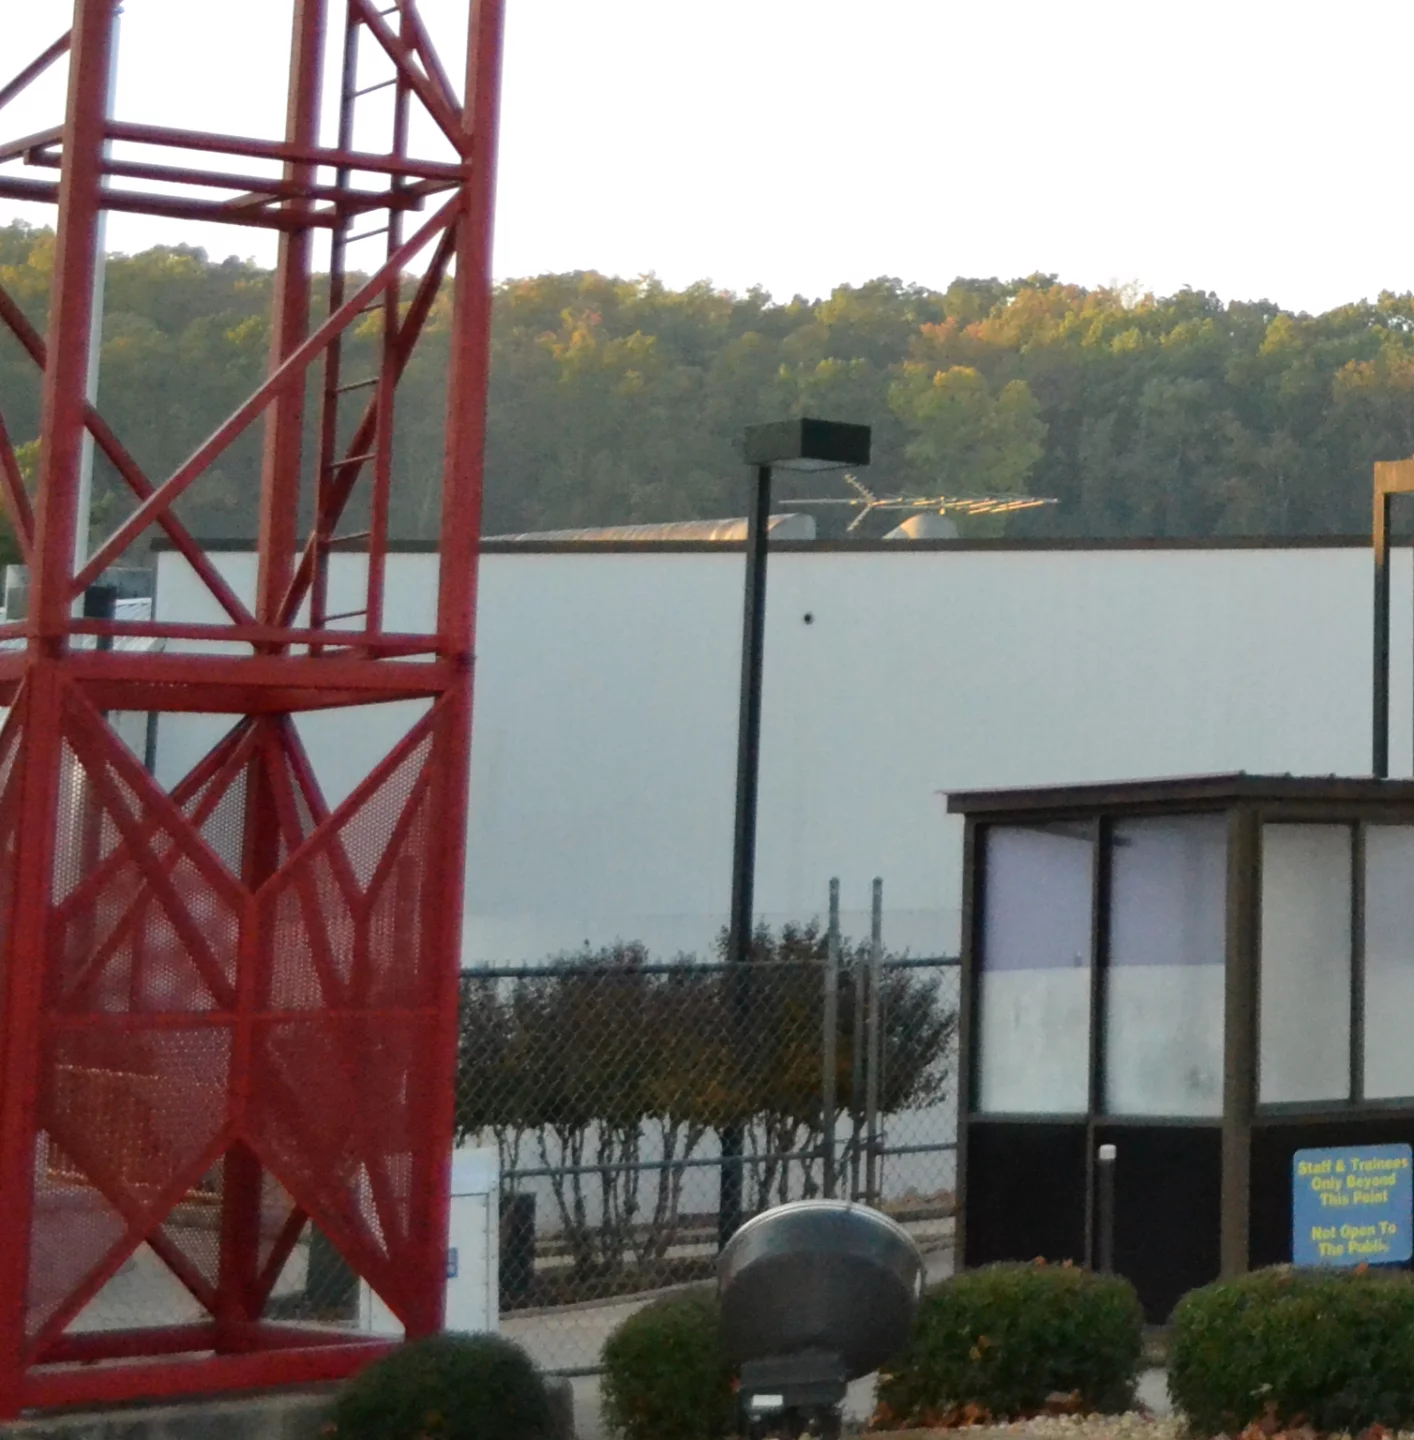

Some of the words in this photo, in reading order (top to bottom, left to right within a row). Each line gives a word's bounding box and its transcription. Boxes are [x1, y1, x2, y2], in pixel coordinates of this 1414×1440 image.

[1298, 1160, 1332, 1176] Staff
[1335, 1159, 1345, 1173] &
[1351, 1157, 1408, 1172] Trainees
[1312, 1176, 1342, 1192] Only
[1346, 1172, 1396, 1189] Beyond
[1320, 1192, 1349, 1206] This
[1353, 1190, 1388, 1205] Point
[1312, 1225, 1336, 1241] Not
[1340, 1223, 1376, 1240] Open
[1379, 1220, 1397, 1236] To
[1319, 1242, 1344, 1257] The
[1348, 1238, 1389, 1255] Public
